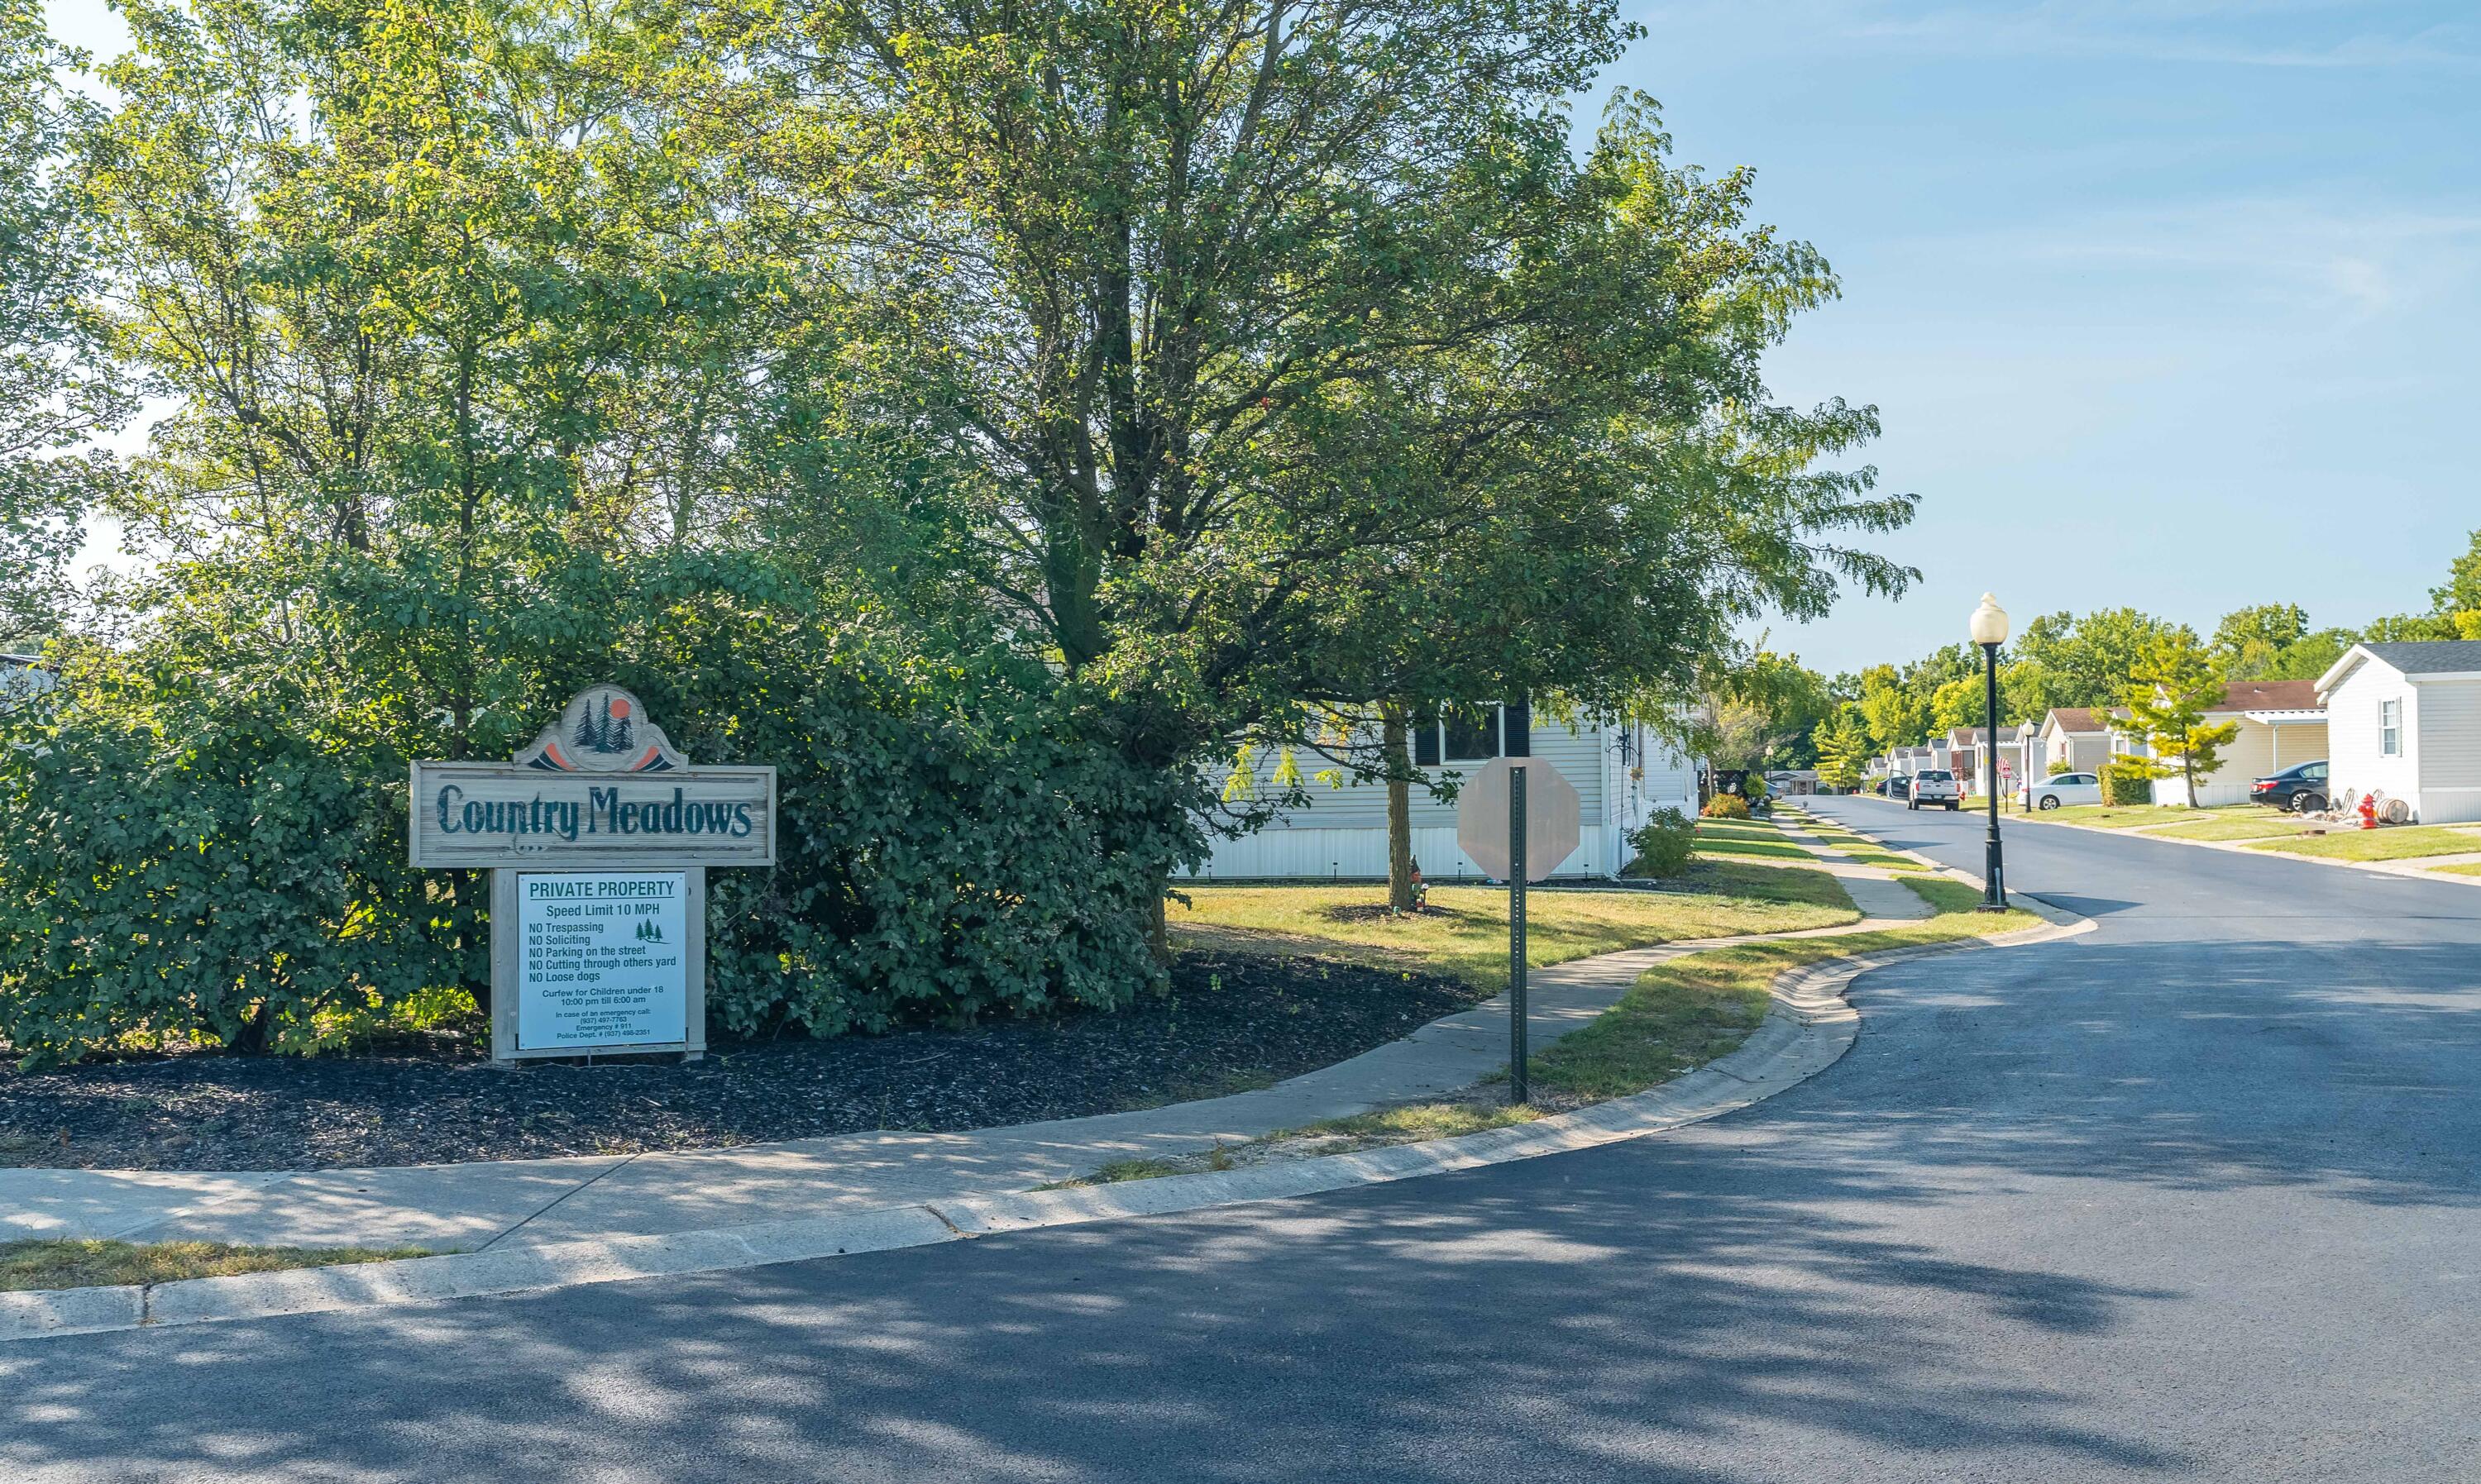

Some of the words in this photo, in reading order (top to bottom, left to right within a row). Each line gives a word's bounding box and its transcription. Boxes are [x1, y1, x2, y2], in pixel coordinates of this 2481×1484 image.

[437, 784, 578, 842] Country
[588, 786, 753, 838] Meadows
[530, 882, 593, 897] PRIVATE
[599, 881, 675, 896] PROPERTY
[547, 905, 581, 919] Speed
[586, 904, 614, 916] Limit
[617, 904, 631, 915] 10
[635, 903, 660, 914] MPH
[529, 923, 543, 933] NO
[546, 923, 604, 933] Trespassing
[529, 936, 543, 945] NO
[546, 935, 590, 946] Soliciting
[529, 948, 543, 957] NO
[546, 947, 582, 958] Parking
[586, 948, 597, 957] on
[600, 947, 615, 956] the
[619, 946, 646, 955] street
[529, 961, 543, 970] NO
[546, 960, 580, 971] Cutting
[584, 957, 620, 969] through
[624, 957, 653, 967] others
[656, 957, 676, 968] yard
[529, 973, 543, 982] NO
[546, 972, 574, 982] Loose
[577, 971, 600, 982] dogs
